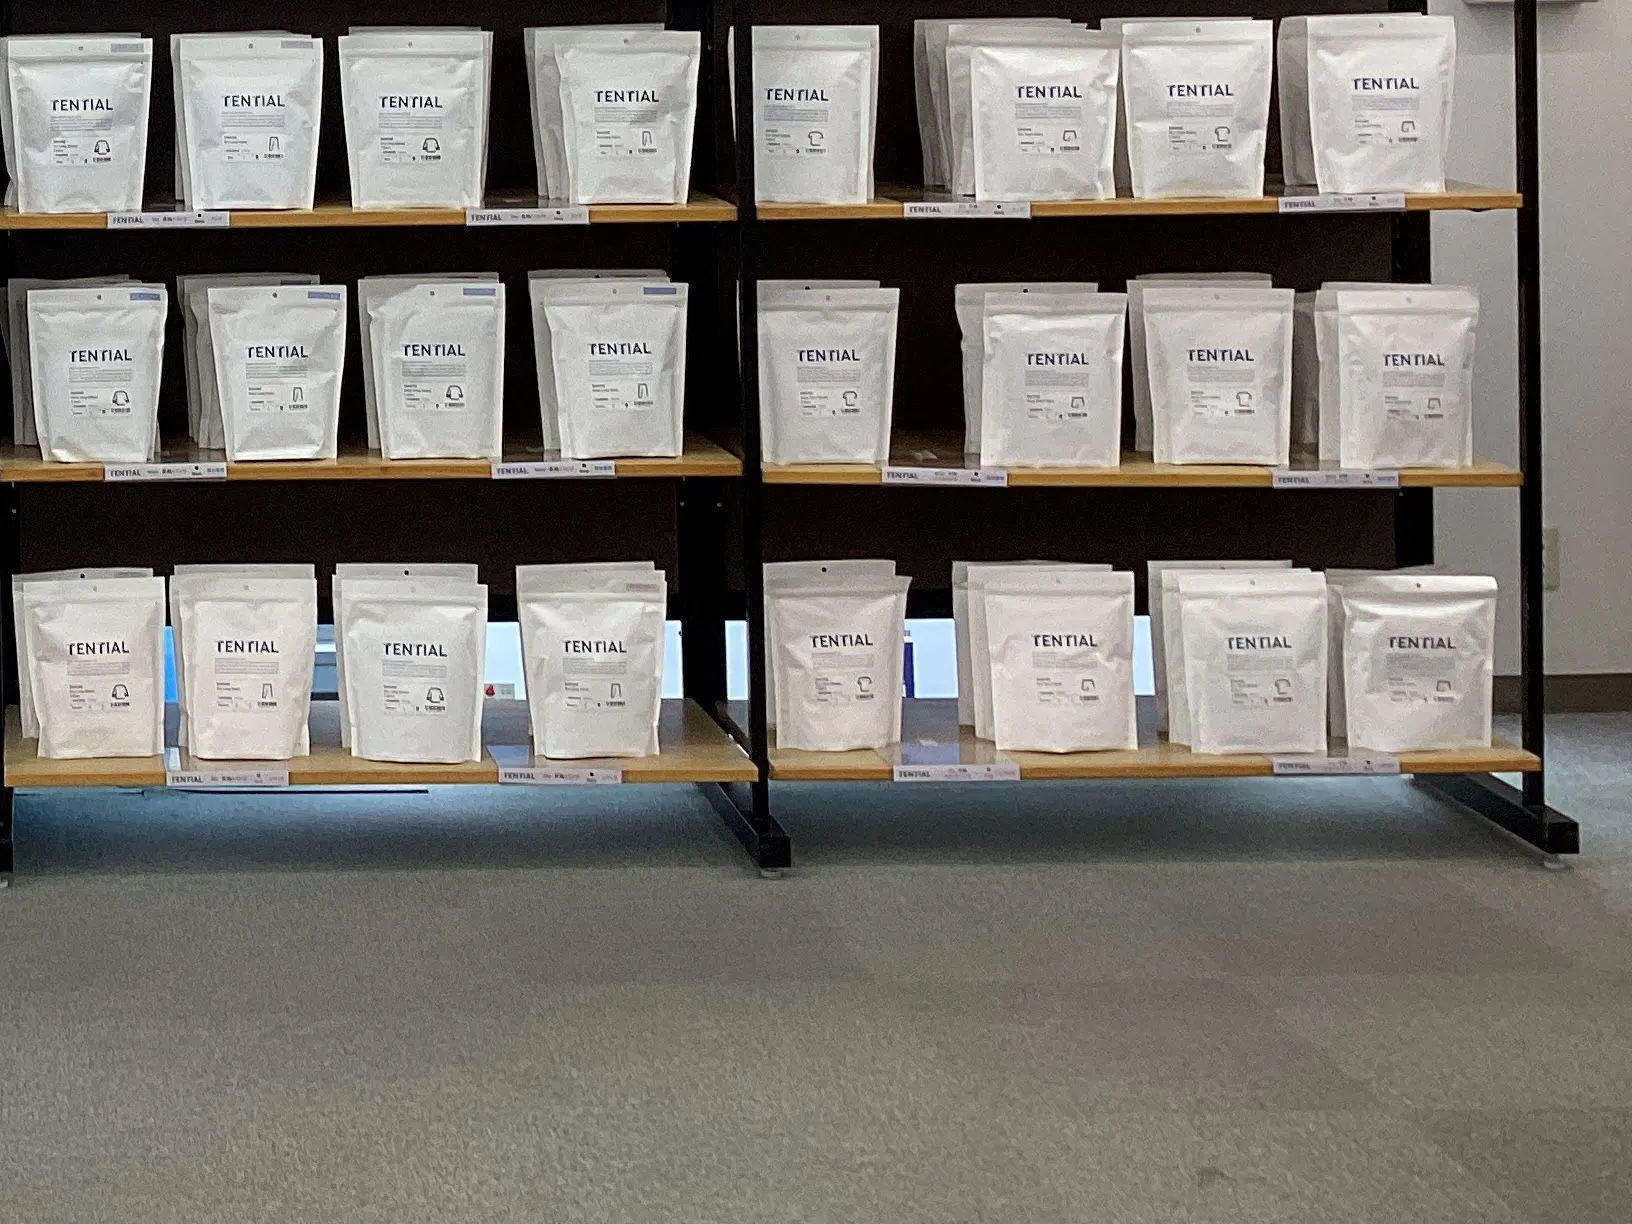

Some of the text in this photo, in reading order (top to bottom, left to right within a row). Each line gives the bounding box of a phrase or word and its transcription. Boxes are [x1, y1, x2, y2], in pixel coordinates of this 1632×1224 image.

[1168, 84, 1234, 97] TENTIAL
[1352, 77, 1420, 90] TENTIAL
[595, 90, 660, 103] TENTIAL
[765, 88, 829, 102] TENTIAL
[1016, 85, 1083, 99] TENTIAL
[51, 98, 114, 112] TENTIAL
[223, 94, 286, 108] TENTIAL
[380, 95, 443, 109] TENTIAL
[70, 349, 133, 363] TENTIAL
[247, 345, 309, 359] TENTIAL
[403, 343, 466, 357] TENTIAL
[589, 342, 652, 356] TENTIAL
[798, 349, 861, 362] TENTIAL
[1187, 349, 1255, 362] TENTIAL
[1026, 352, 1089, 366] TENTIAL
[1382, 353, 1445, 367] TENTIAL
[216, 640, 279, 654] TENTIAL
[563, 640, 627, 654] TENTIAL
[810, 633, 874, 648] TENTIAL
[1032, 634, 1099, 648] TENTIAL
[1226, 636, 1292, 651] TENTIAL
[1388, 636, 1457, 650] TENTIAL
[68, 641, 130, 656] TENTIAL
[384, 642, 448, 658] TENTIAL
